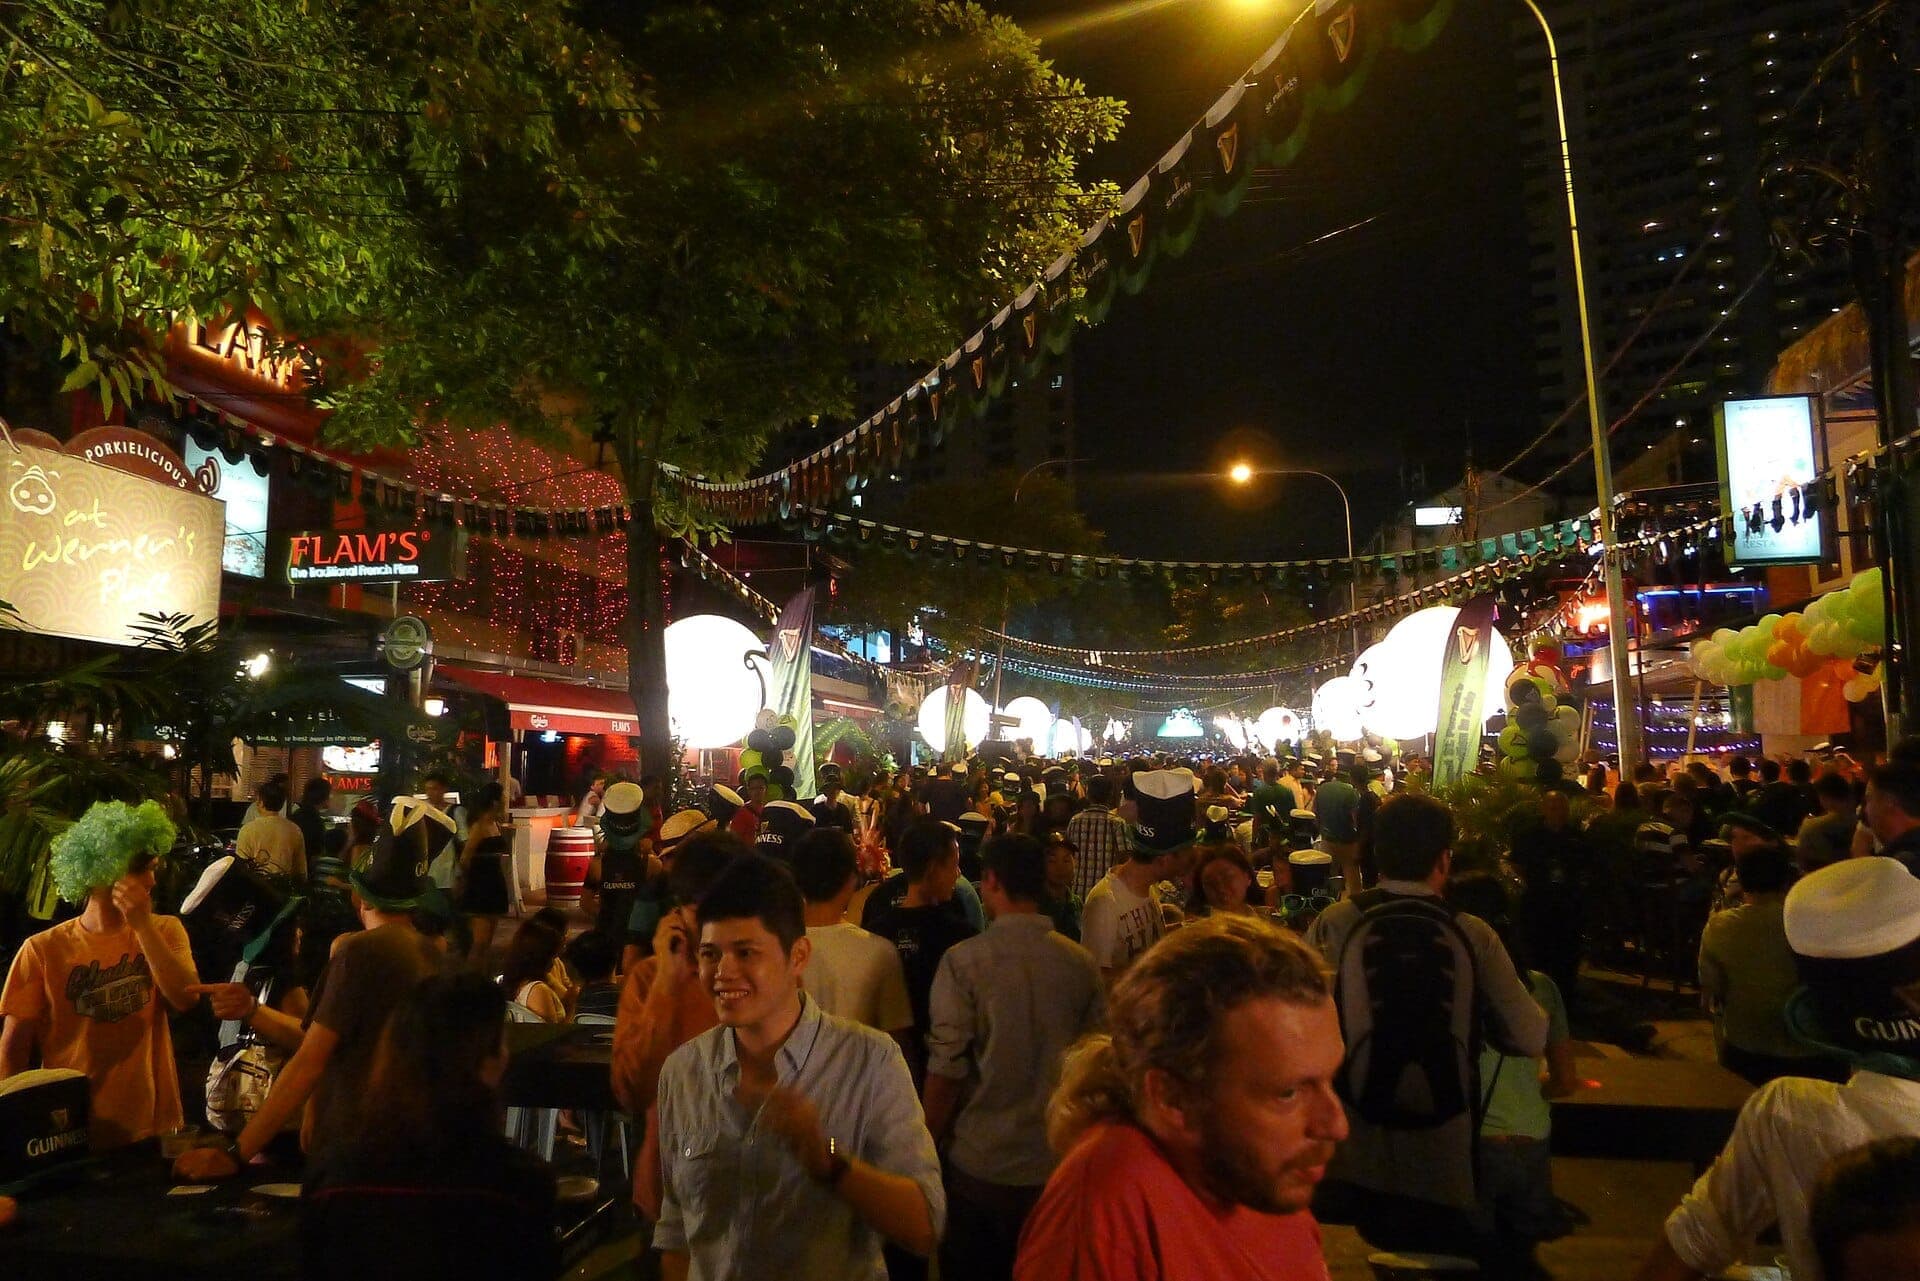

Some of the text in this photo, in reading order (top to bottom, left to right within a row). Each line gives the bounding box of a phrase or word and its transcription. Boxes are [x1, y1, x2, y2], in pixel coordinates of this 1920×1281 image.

[85, 441, 188, 488] PORKIELICIOUS
[64, 498, 107, 528] at
[290, 531, 418, 566] FLAM'S
